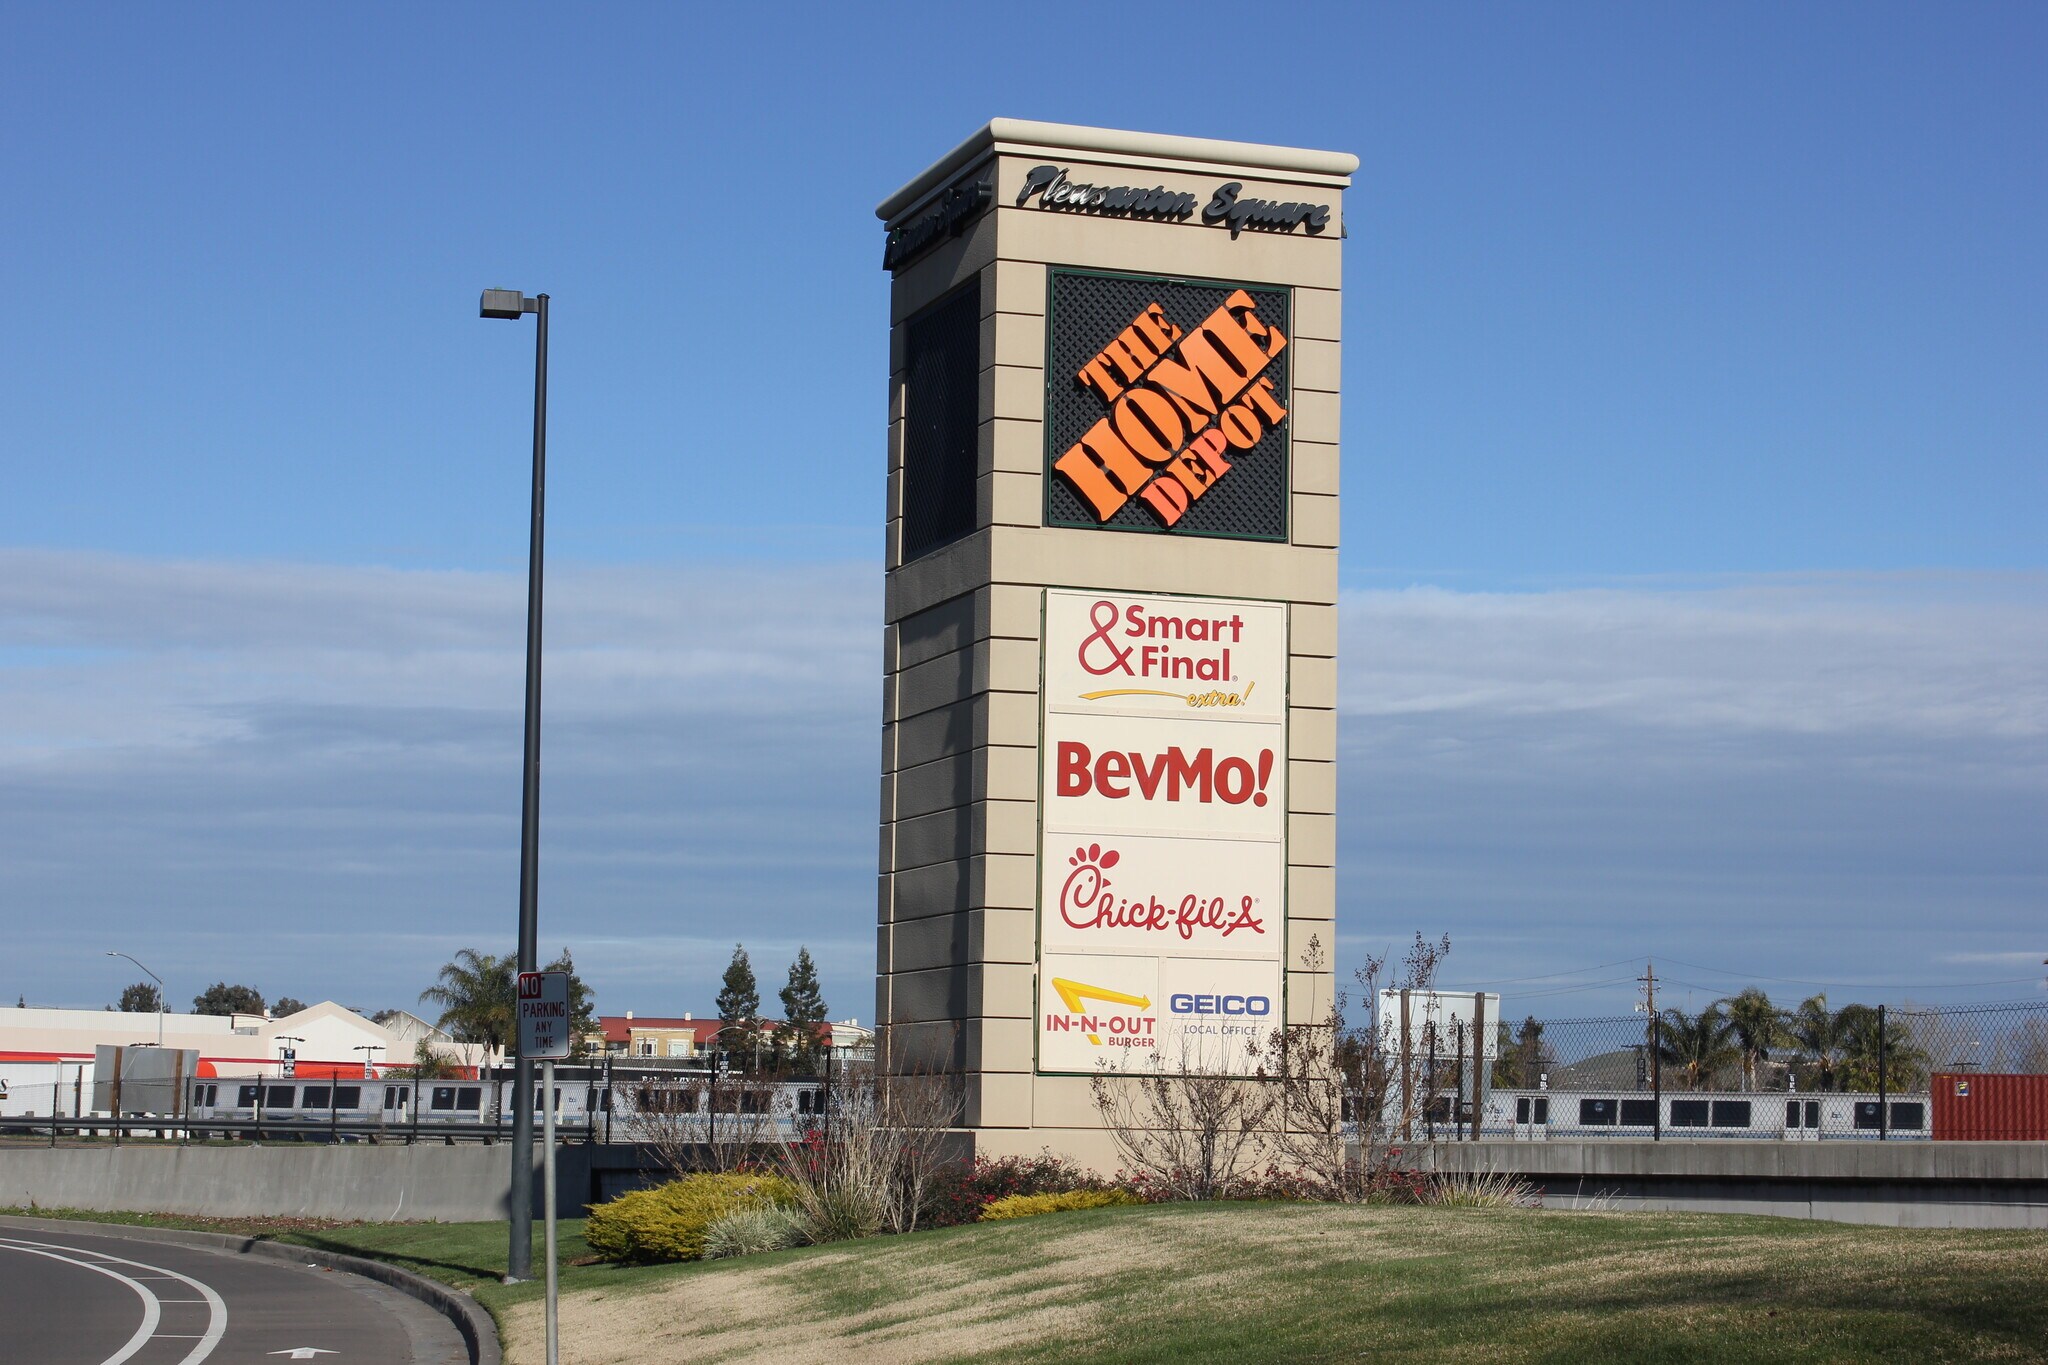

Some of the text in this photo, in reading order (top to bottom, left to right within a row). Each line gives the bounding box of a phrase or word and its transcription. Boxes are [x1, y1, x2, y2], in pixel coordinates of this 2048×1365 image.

[1015, 164, 1331, 241] Pleasanton Square
[1077, 302, 1184, 405] THE
[1054, 289, 1288, 523] HOME
[1140, 376, 1289, 528] DEPOT
[1078, 600, 1244, 677] & Smart
[1141, 644, 1231, 682] Final
[1186, 680, 1256, 708] extra!
[1056, 740, 1274, 808] BevMo!
[1059, 863, 1265, 940] Chick-fil-A
[521, 976, 539, 996] NO
[522, 1001, 565, 1018] PARKING
[1170, 993, 1270, 1016] GEICO
[535, 1020, 553, 1033] ANY
[1046, 1014, 1156, 1035] IN-N-OUT
[1184, 1025, 1218, 1035] LOCAL
[1221, 1026, 1257, 1036] OFFICE
[535, 1036, 554, 1049] TIME
[1108, 1036, 1155, 1047] BURGER
